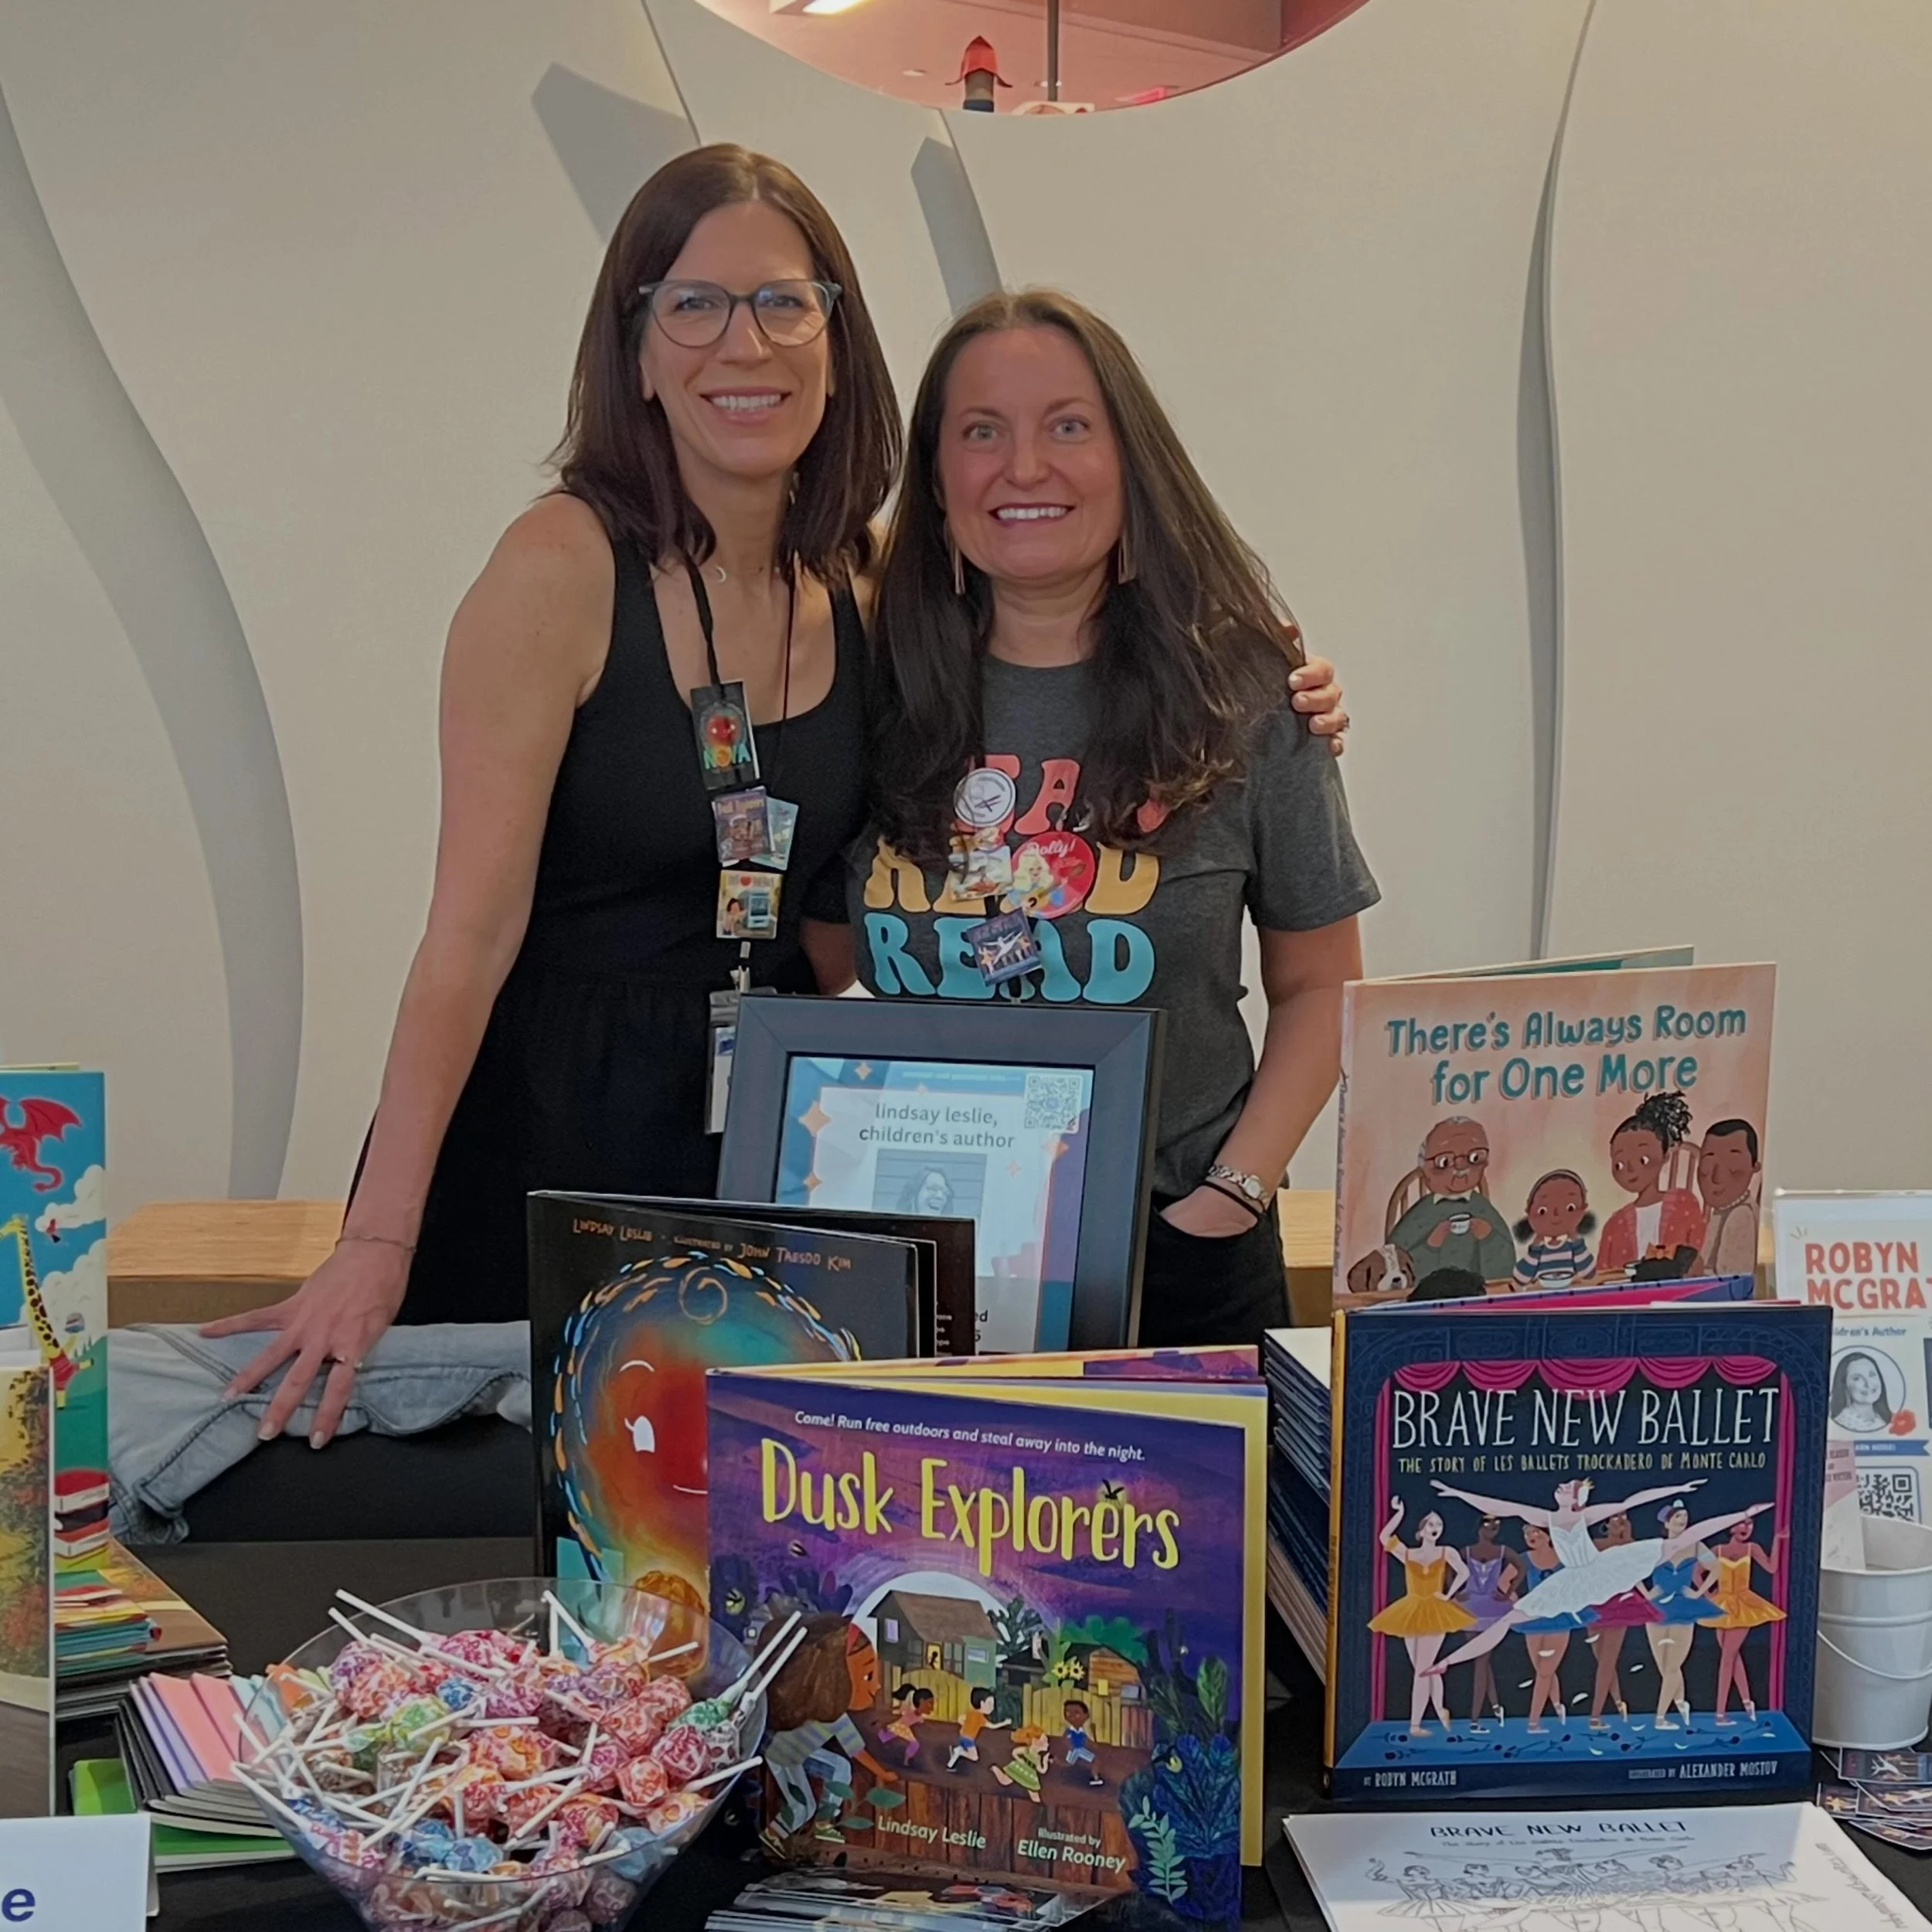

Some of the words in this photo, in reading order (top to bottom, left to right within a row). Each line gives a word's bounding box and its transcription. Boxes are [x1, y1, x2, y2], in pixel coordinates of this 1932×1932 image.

[703, 743, 752, 770] NOVA
[1385, 1012, 1510, 1056] There's
[1522, 1011, 1642, 1047] Always
[1652, 1005, 1747, 1041] Room
[1432, 1060, 1491, 1105] for
[1500, 1056, 1585, 1100] One
[1597, 1053, 1698, 1096] More
[875, 1104, 940, 1125] lindsay
[946, 1106, 998, 1128] leslie,
[859, 1128, 948, 1145] children's
[954, 1131, 1015, 1149] author
[737, 1243, 770, 1260] JOHN
[1804, 1242, 1919, 1274] ROBYN
[1393, 1389, 1516, 1449] BRAVE
[1531, 1387, 1628, 1447] NEW
[1638, 1387, 1779, 1445] BALLET
[794, 1410, 835, 1427] Come!
[837, 1415, 862, 1430] Run
[865, 1417, 889, 1432] free
[893, 1422, 950, 1439] outdoors
[952, 1428, 979, 1442] and
[981, 1432, 1013, 1447] steal
[1015, 1438, 1052, 1454] away
[1054, 1438, 1080, 1454] into
[1084, 1440, 1106, 1457] the
[1108, 1445, 1145, 1463] night.
[1398, 1458, 1423, 1474] THE
[1429, 1457, 1465, 1473] STORY
[1473, 1456, 1487, 1472] OF
[1494, 1455, 1514, 1471] LES
[1521, 1454, 1570, 1471] BALLETS
[1577, 1453, 1653, 1470] TROCKADERO
[1662, 1453, 1673, 1470] DE
[1681, 1452, 1723, 1469] MONTE
[1729, 1452, 1766, 1468] CARLO
[760, 1437, 894, 1535] Dusk
[921, 1458, 1181, 1577] Explorers
[1679, 1763, 1735, 1779] ALEXANDER
[1740, 1760, 1777, 1776] MOSTOV
[877, 1815, 938, 1844] Lindsay
[942, 1825, 987, 1849] Leslie
[1038, 1826, 1087, 1845] Illustrated
[1089, 1835, 1101, 1848] by
[1430, 1825, 1515, 1838] BRAVE
[1526, 1824, 1582, 1836] NEW
[1597, 1821, 1687, 1834] BALLET
[1018, 1839, 1058, 1861] Ellen
[1062, 1846, 1126, 1873] Rooney
[2, 1888, 36, 1923] e
